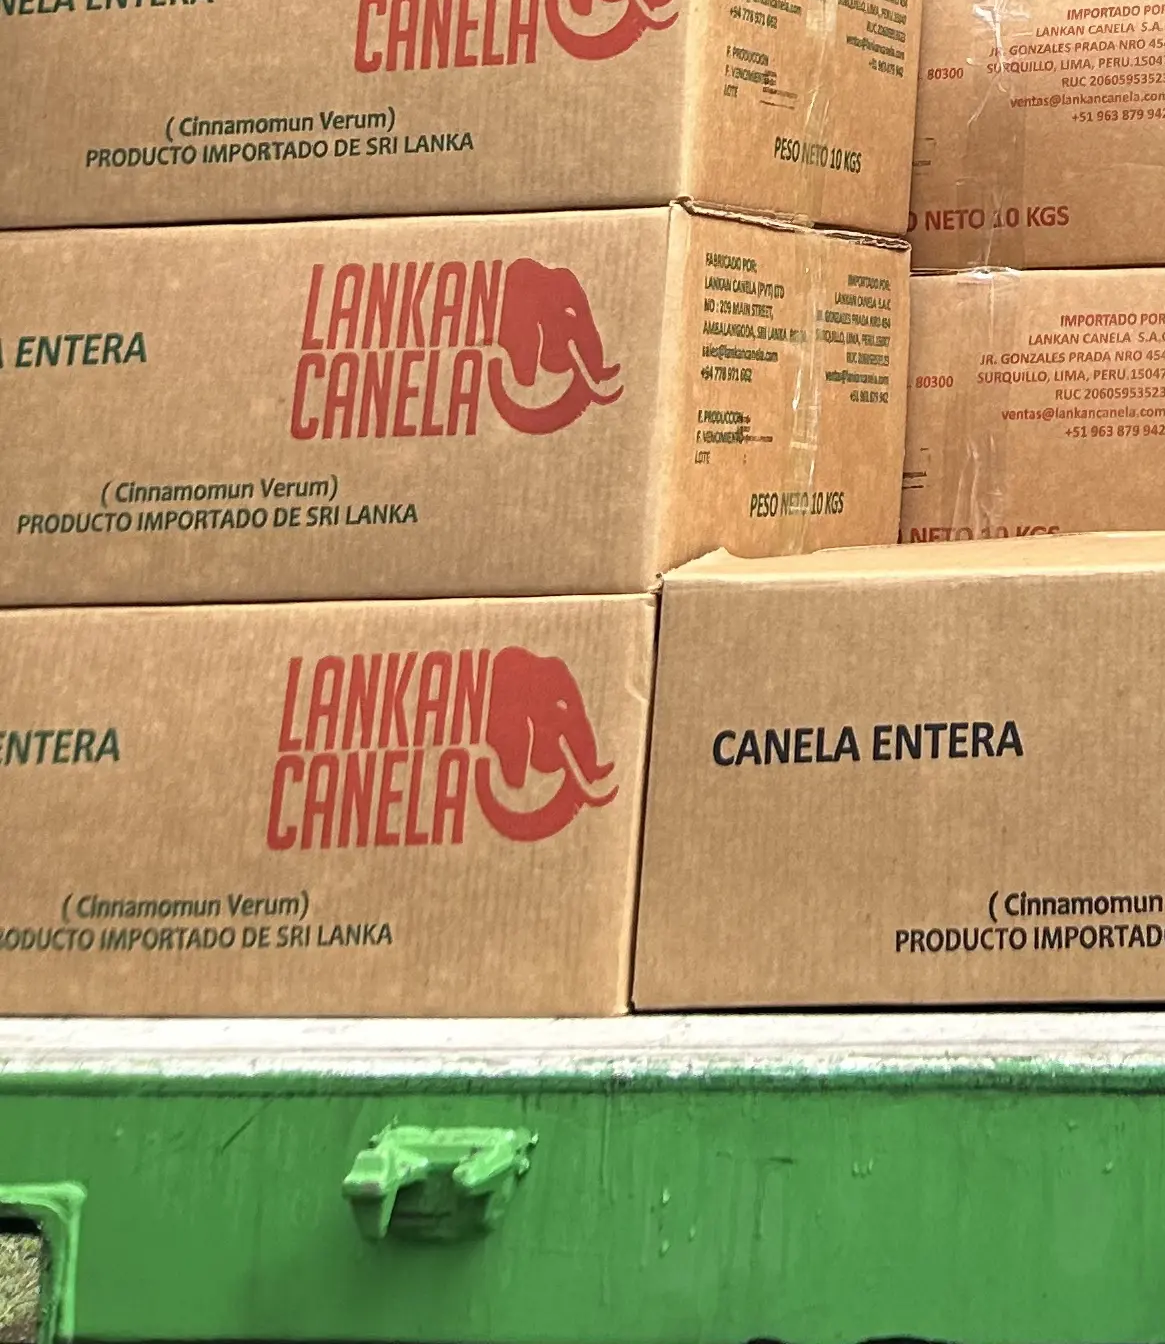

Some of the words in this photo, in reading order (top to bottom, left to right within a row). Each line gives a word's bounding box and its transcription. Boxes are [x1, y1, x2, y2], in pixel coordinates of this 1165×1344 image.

[85, 144, 197, 168] PRODUCTO
[202, 139, 329, 165] IMPORTADO
[333, 137, 361, 158] DE
[365, 135, 398, 157] SRI
[404, 131, 474, 155] LANKA
[302, 260, 502, 352] LANKAN
[14, 331, 147, 370] ENTERA
[291, 349, 483, 440] CANELA
[279, 648, 491, 753] LANKAN
[0, 727, 120, 767] NTERA
[712, 725, 861, 768] CANELA
[872, 719, 1024, 763] ENTERA
[266, 747, 470, 851] CANELA
[895, 926, 1028, 954] PRODUCTO
